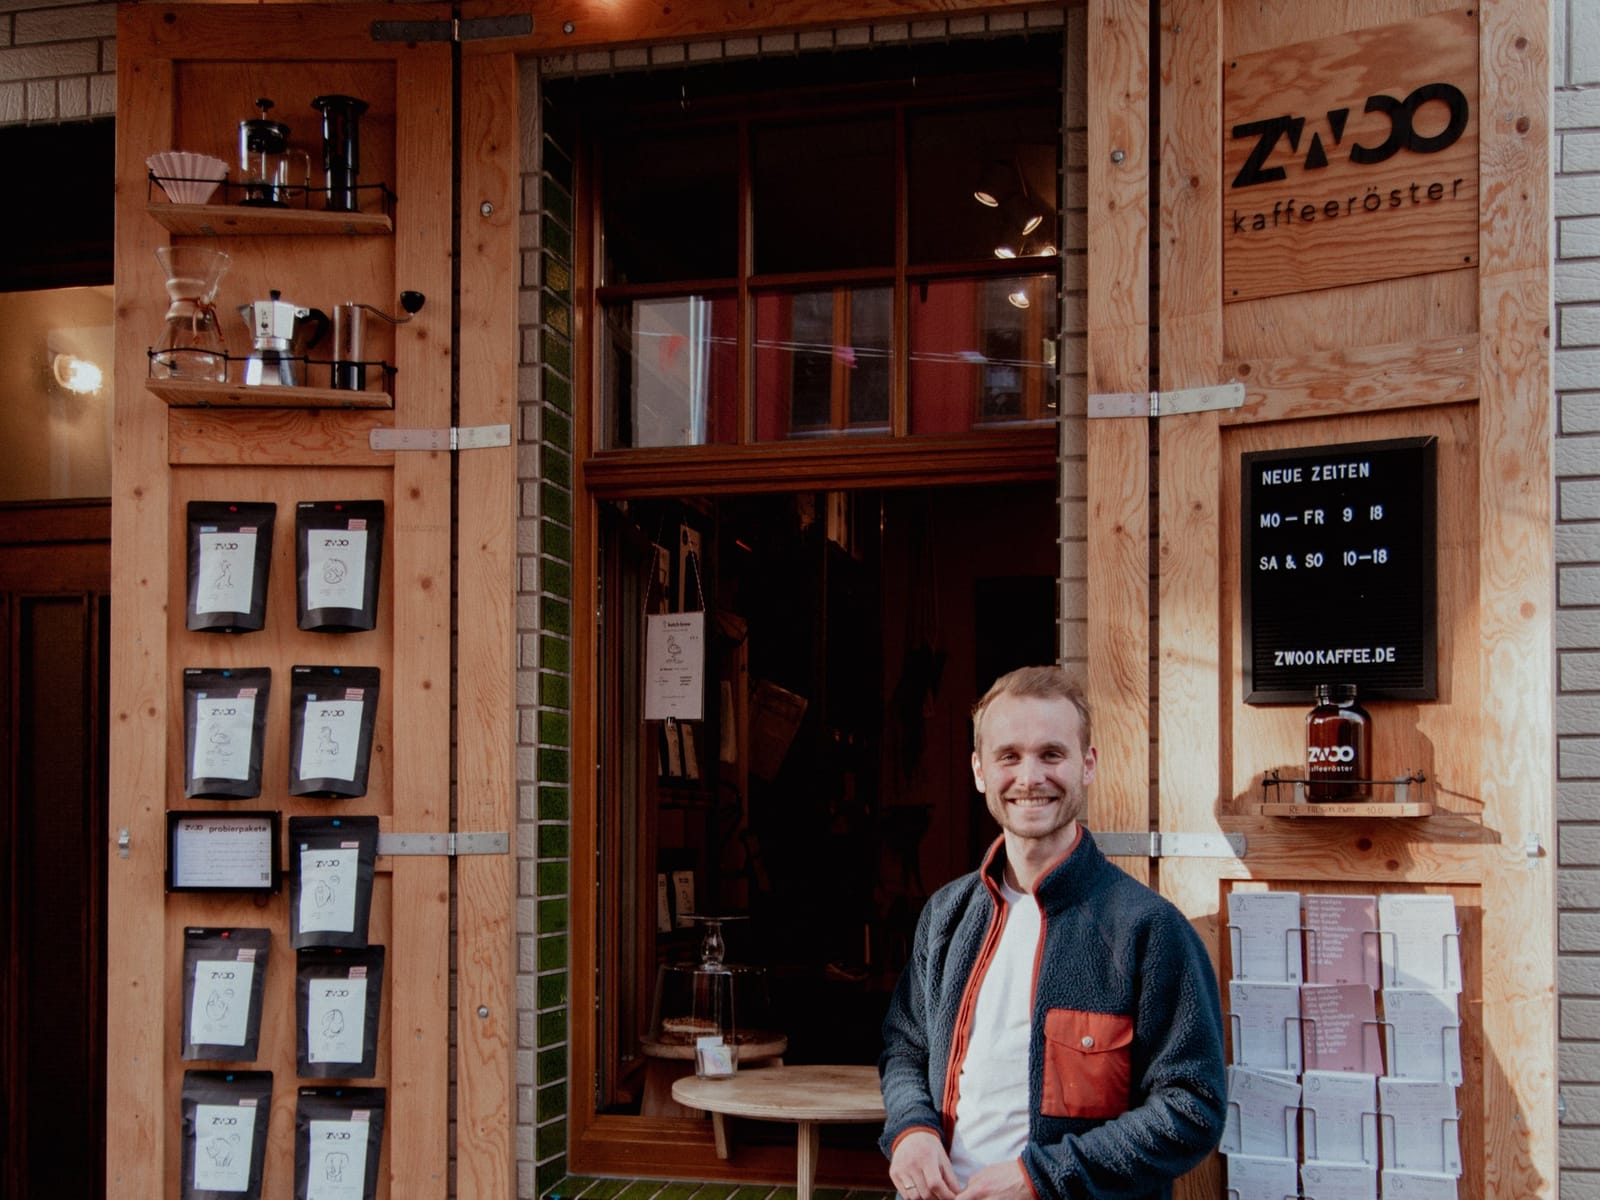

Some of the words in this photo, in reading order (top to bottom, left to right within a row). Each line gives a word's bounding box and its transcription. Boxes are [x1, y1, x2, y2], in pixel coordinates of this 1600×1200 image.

[1233, 178, 1463, 233] kaffeeröster
[1262, 468, 1302, 486] NEUE
[1311, 462, 1370, 482] ZEITEN
[1343, 507, 1353, 522] 9
[1370, 505, 1383, 520] 18
[1259, 556, 1278, 571] SA
[1285, 555, 1297, 569] &
[1305, 553, 1324, 568] SO
[1274, 648, 1395, 666] ZWOOKAFFEE.DE
[208, 824, 267, 834] probierpakete
